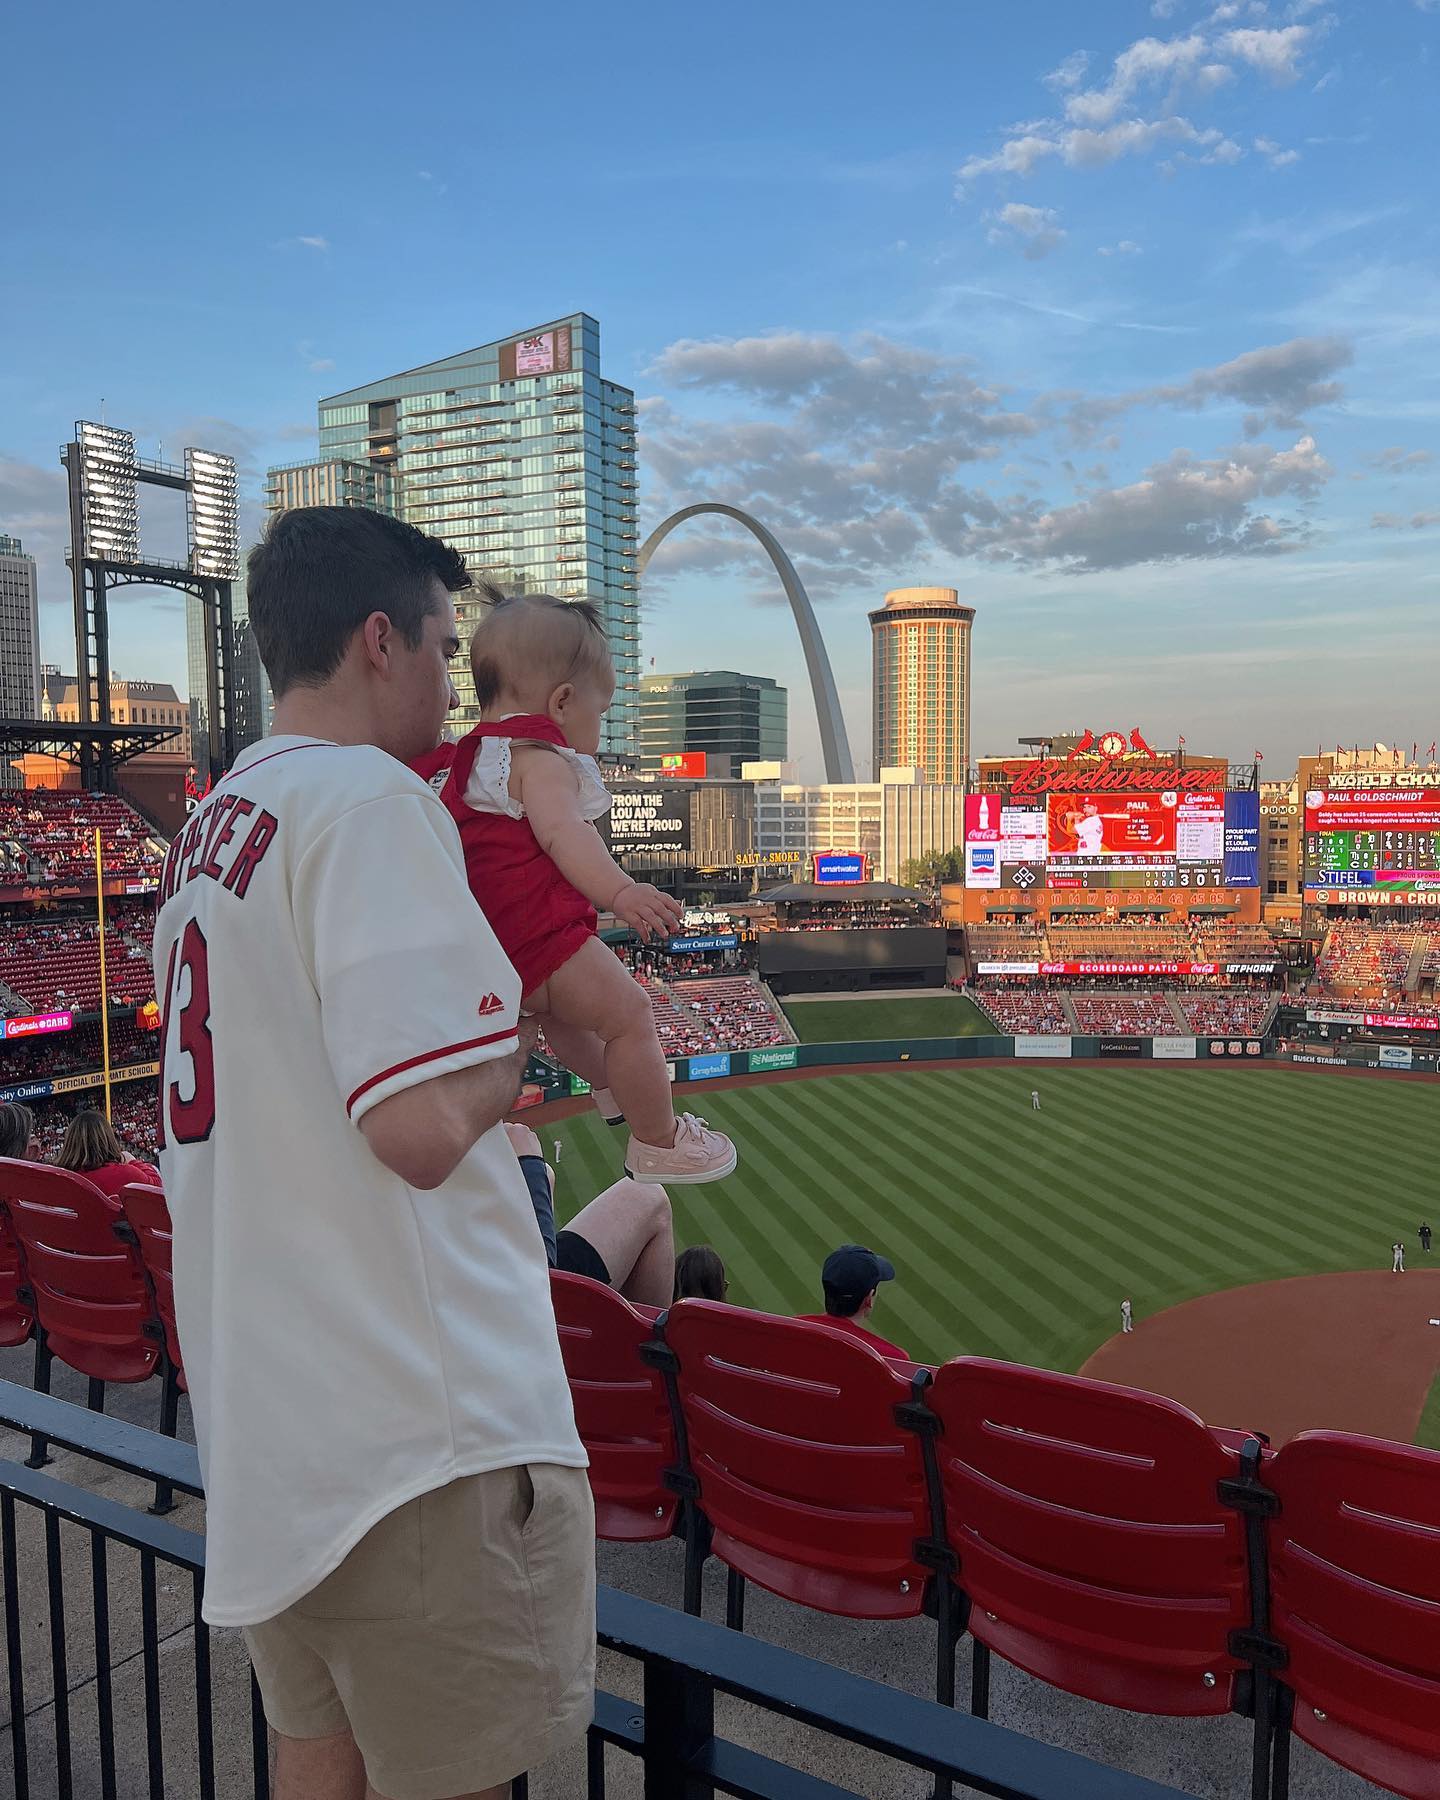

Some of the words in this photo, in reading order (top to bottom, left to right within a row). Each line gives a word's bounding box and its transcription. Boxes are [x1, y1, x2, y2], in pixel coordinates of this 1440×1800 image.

[1003, 760, 1225, 794] Budweiser
[1328, 773, 1392, 786] WORLD
[612, 794, 642, 807] FROM
[643, 794, 663, 807] THE
[1185, 793, 1215, 804] Cardinals
[1328, 793, 1351, 802] PAUL
[1354, 792, 1424, 802] GOLDSCHMIDT
[611, 807, 633, 820] LOU
[634, 807, 657, 819] AND
[1261, 806, 1296, 814] TUMS
[611, 819, 645, 832] WE'RE
[647, 819, 683, 831] PROUD
[636, 843, 682, 851] PHORM
[735, 853, 761, 865] SALT
[769, 851, 800, 863] SMOKE
[821, 865, 860, 873] smartwater
[1180, 874, 1189, 886] 3
[1196, 874, 1205, 886] 0
[1213, 874, 1220, 886] 1
[1318, 869, 1362, 884] STIFEL
[1338, 891, 1390, 903] BROWN
[1394, 894, 1403, 904] &
[672, 942, 692, 950] SCOTT
[692, 940, 714, 948] CREDIT
[715, 939, 735, 947] UNION
[1149, 964, 1178, 972] PATIO
[8, 1021, 39, 1035] Cardinals
[46, 1016, 69, 1027] CARE
[761, 1051, 795, 1064] National
[1293, 1054, 1315, 1063] BUSCH
[1316, 1056, 1347, 1066] STADIUM
[57, 1076, 89, 1091] OFFICIAL
[91, 1069, 126, 1084] GRAUATE
[128, 1064, 154, 1078] SCHOOL
[17, 1084, 46, 1097] Online
